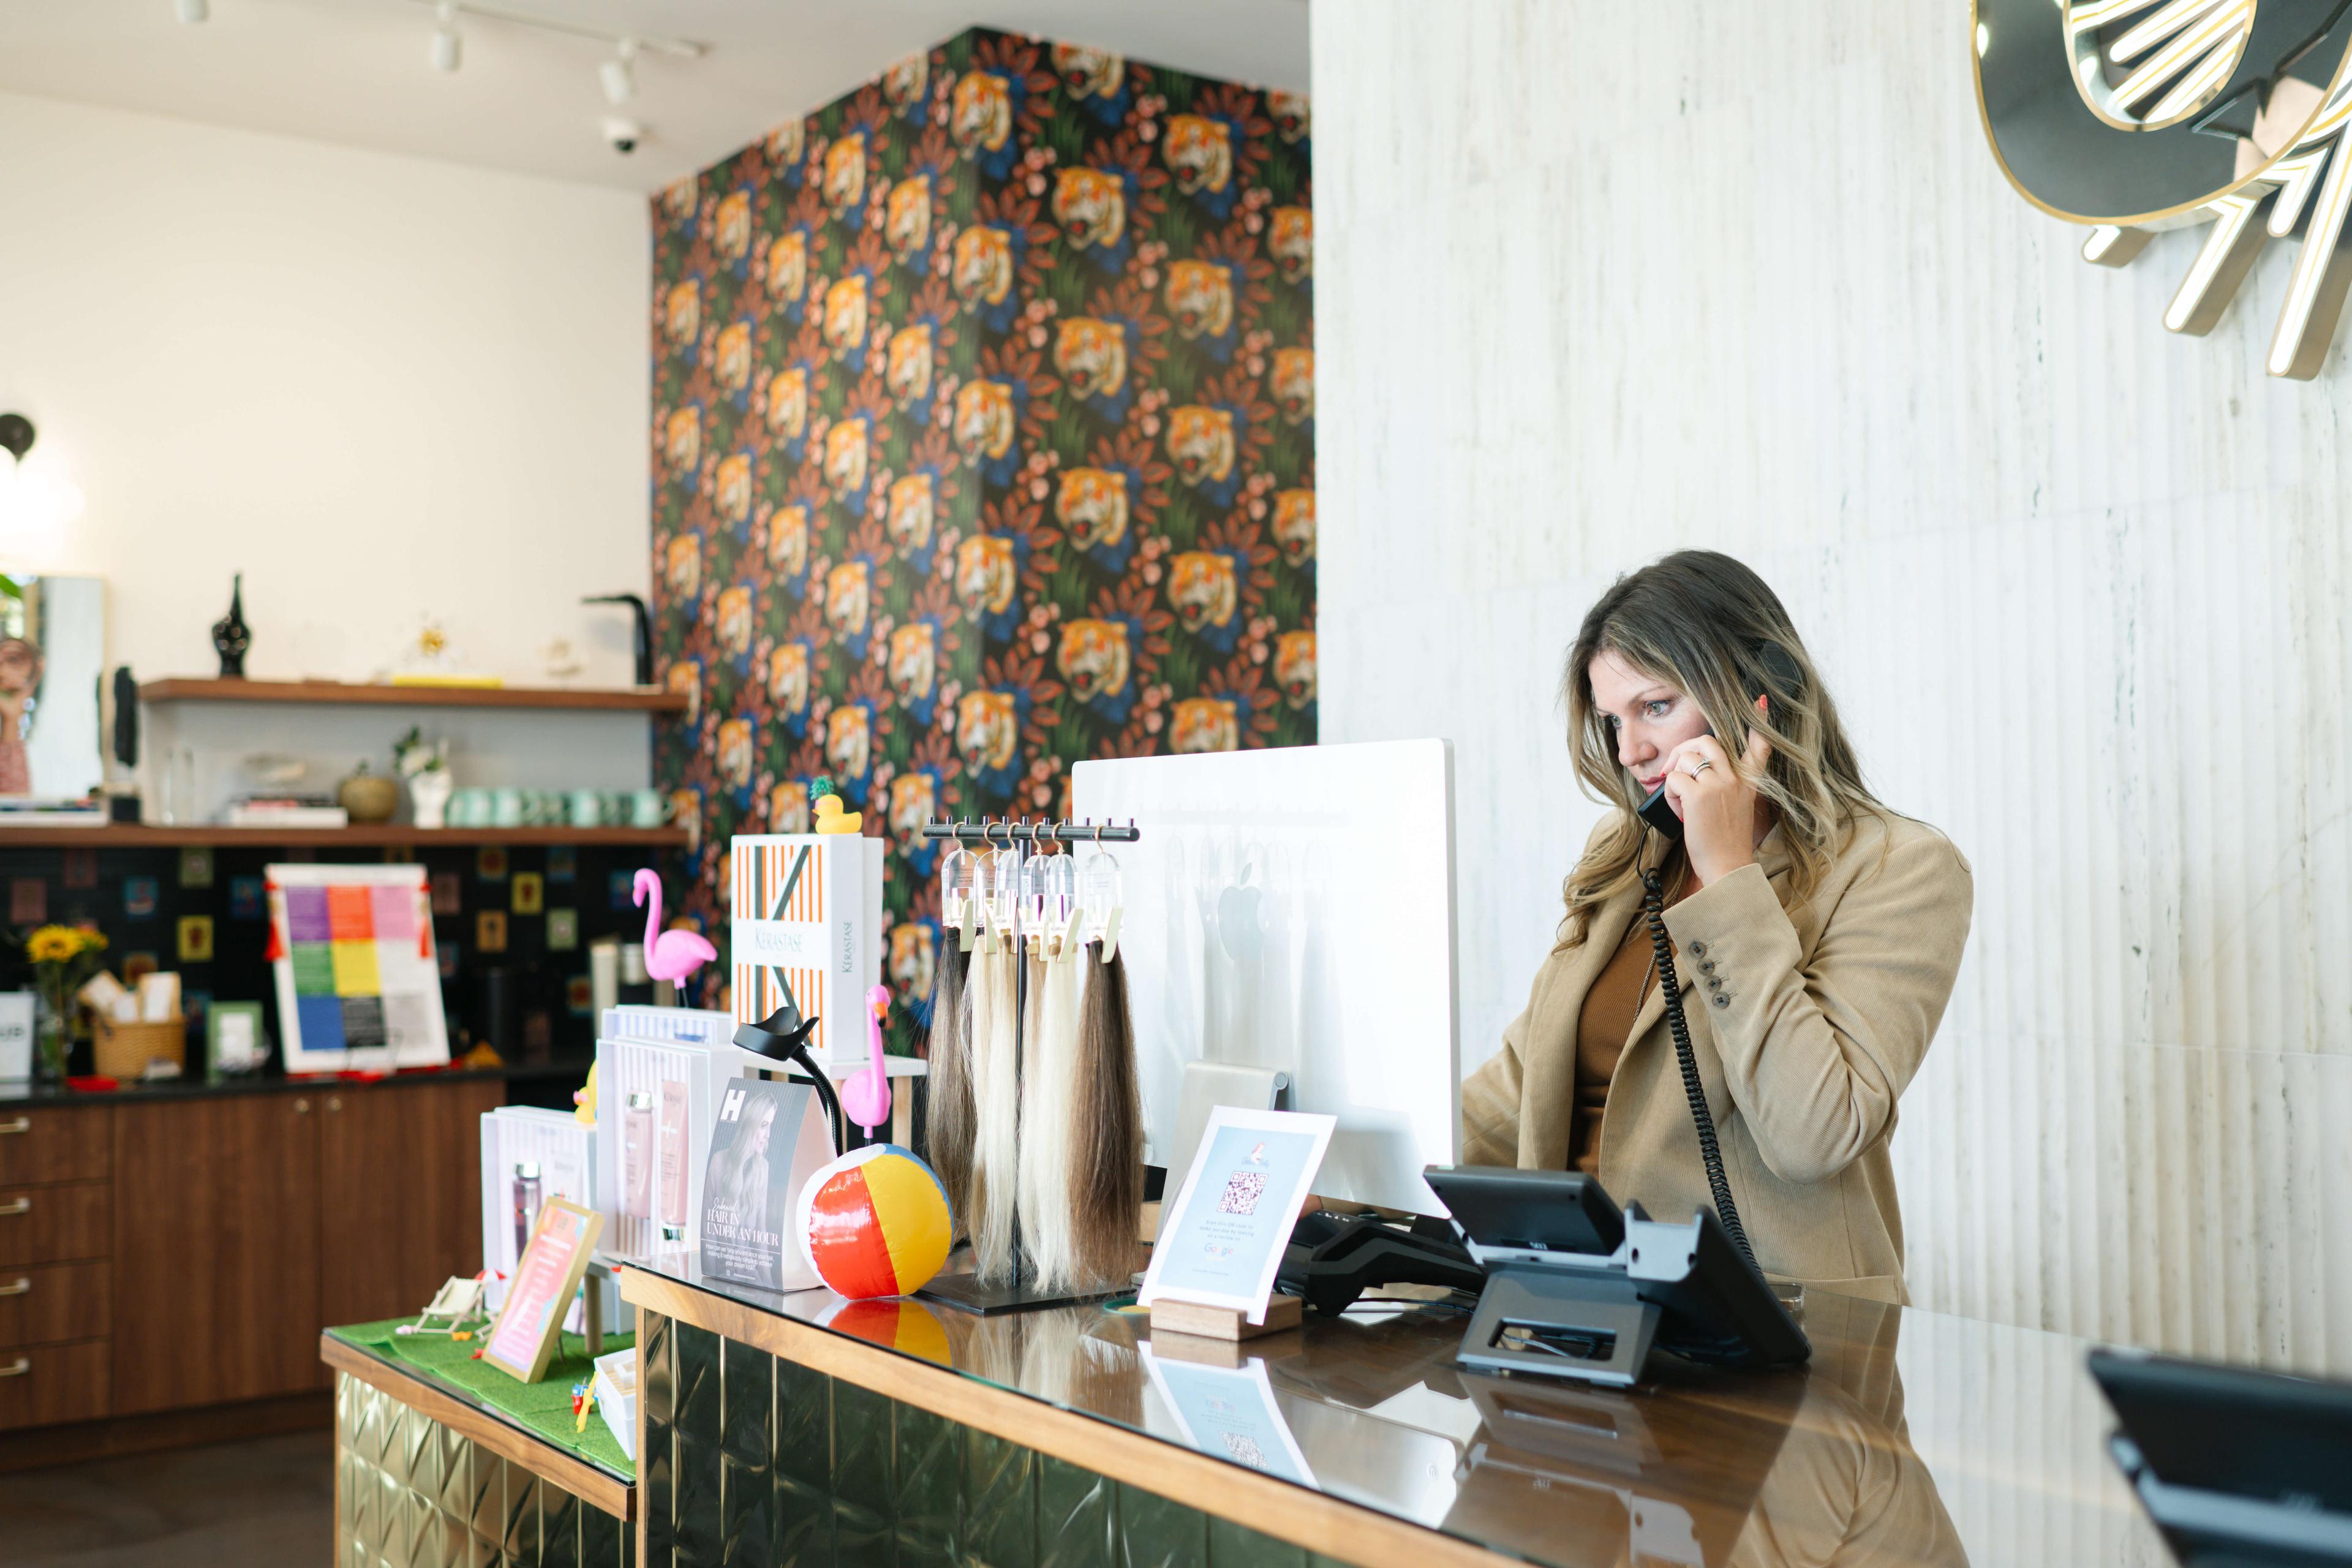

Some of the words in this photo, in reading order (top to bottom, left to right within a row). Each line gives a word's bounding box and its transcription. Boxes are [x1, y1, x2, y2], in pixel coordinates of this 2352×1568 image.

[720, 1089, 747, 1121] H
[707, 1208, 728, 1224] HAIR
[730, 1213, 740, 1225] IN
[707, 1222, 736, 1238] UNDER
[738, 1227, 752, 1242] AN
[753, 1230, 778, 1246] HOUR
[1204, 1242, 1234, 1257] Google
